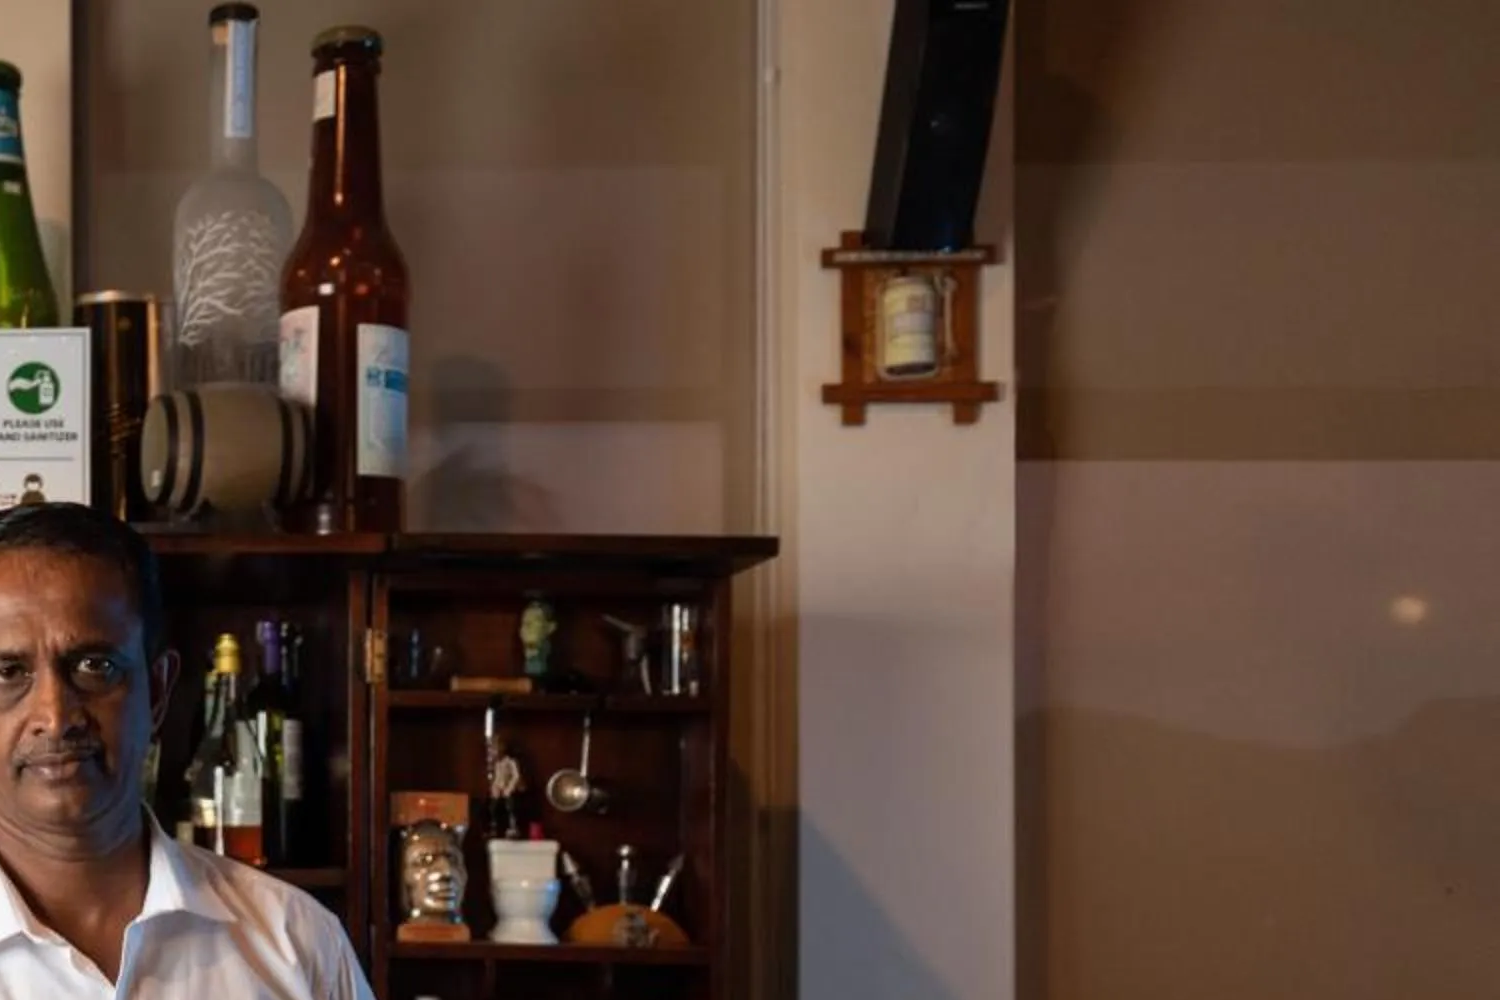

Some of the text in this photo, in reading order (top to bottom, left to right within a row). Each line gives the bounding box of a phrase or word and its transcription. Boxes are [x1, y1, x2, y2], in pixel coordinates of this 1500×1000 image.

[3, 419, 64, 430] PLEASE USE
[24, 431, 78, 442] SANITIZER
